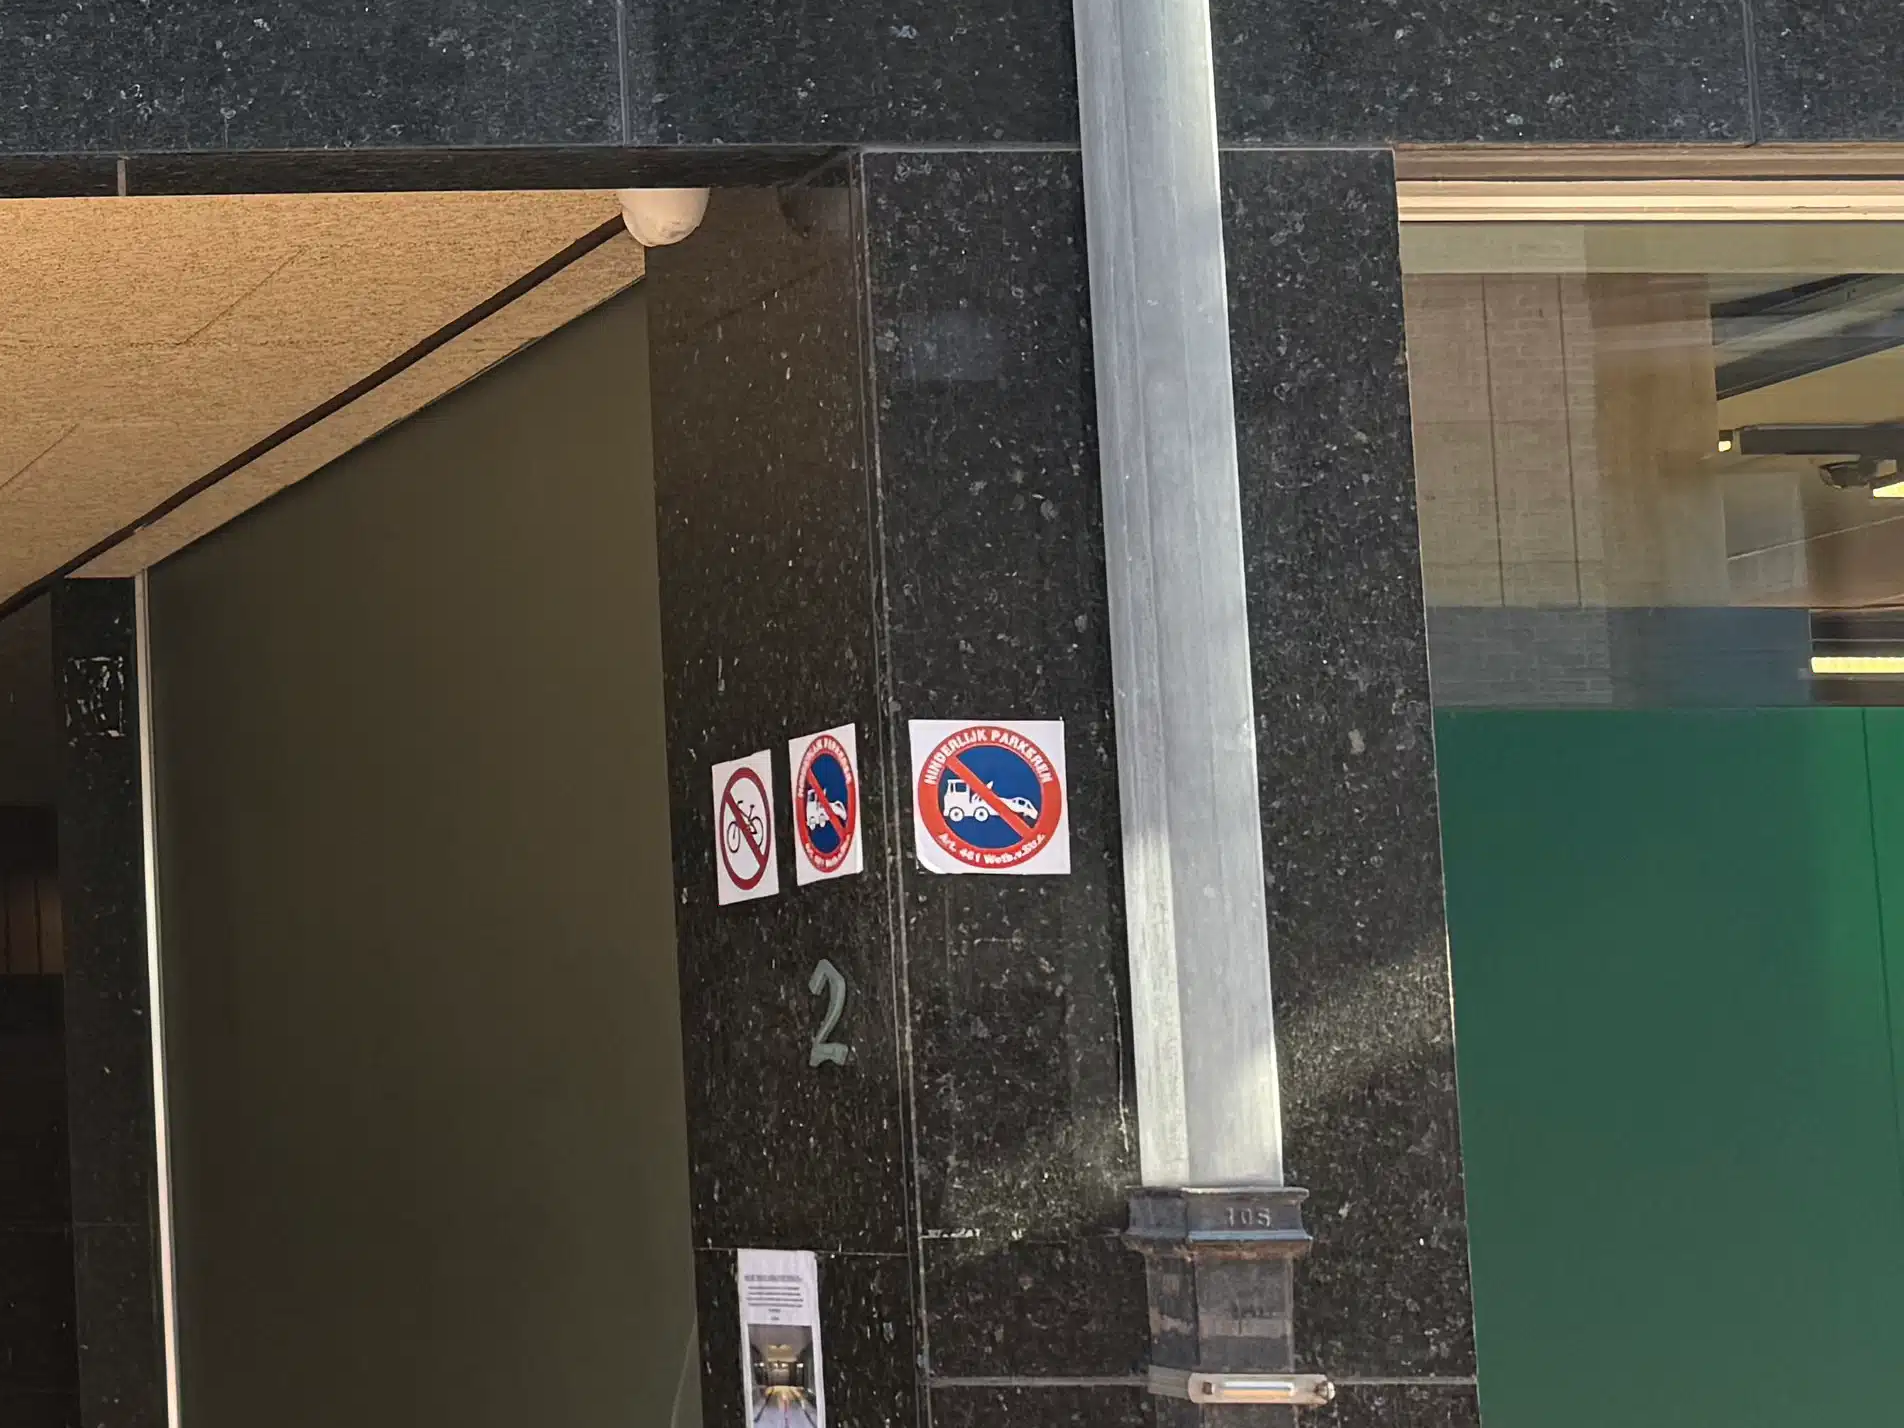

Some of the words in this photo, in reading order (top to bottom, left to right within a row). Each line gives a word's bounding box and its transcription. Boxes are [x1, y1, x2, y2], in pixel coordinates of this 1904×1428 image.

[924, 728, 988, 785] HINDERLIJK
[991, 728, 1054, 784] PARKEREN
[808, 958, 849, 1067] 2
